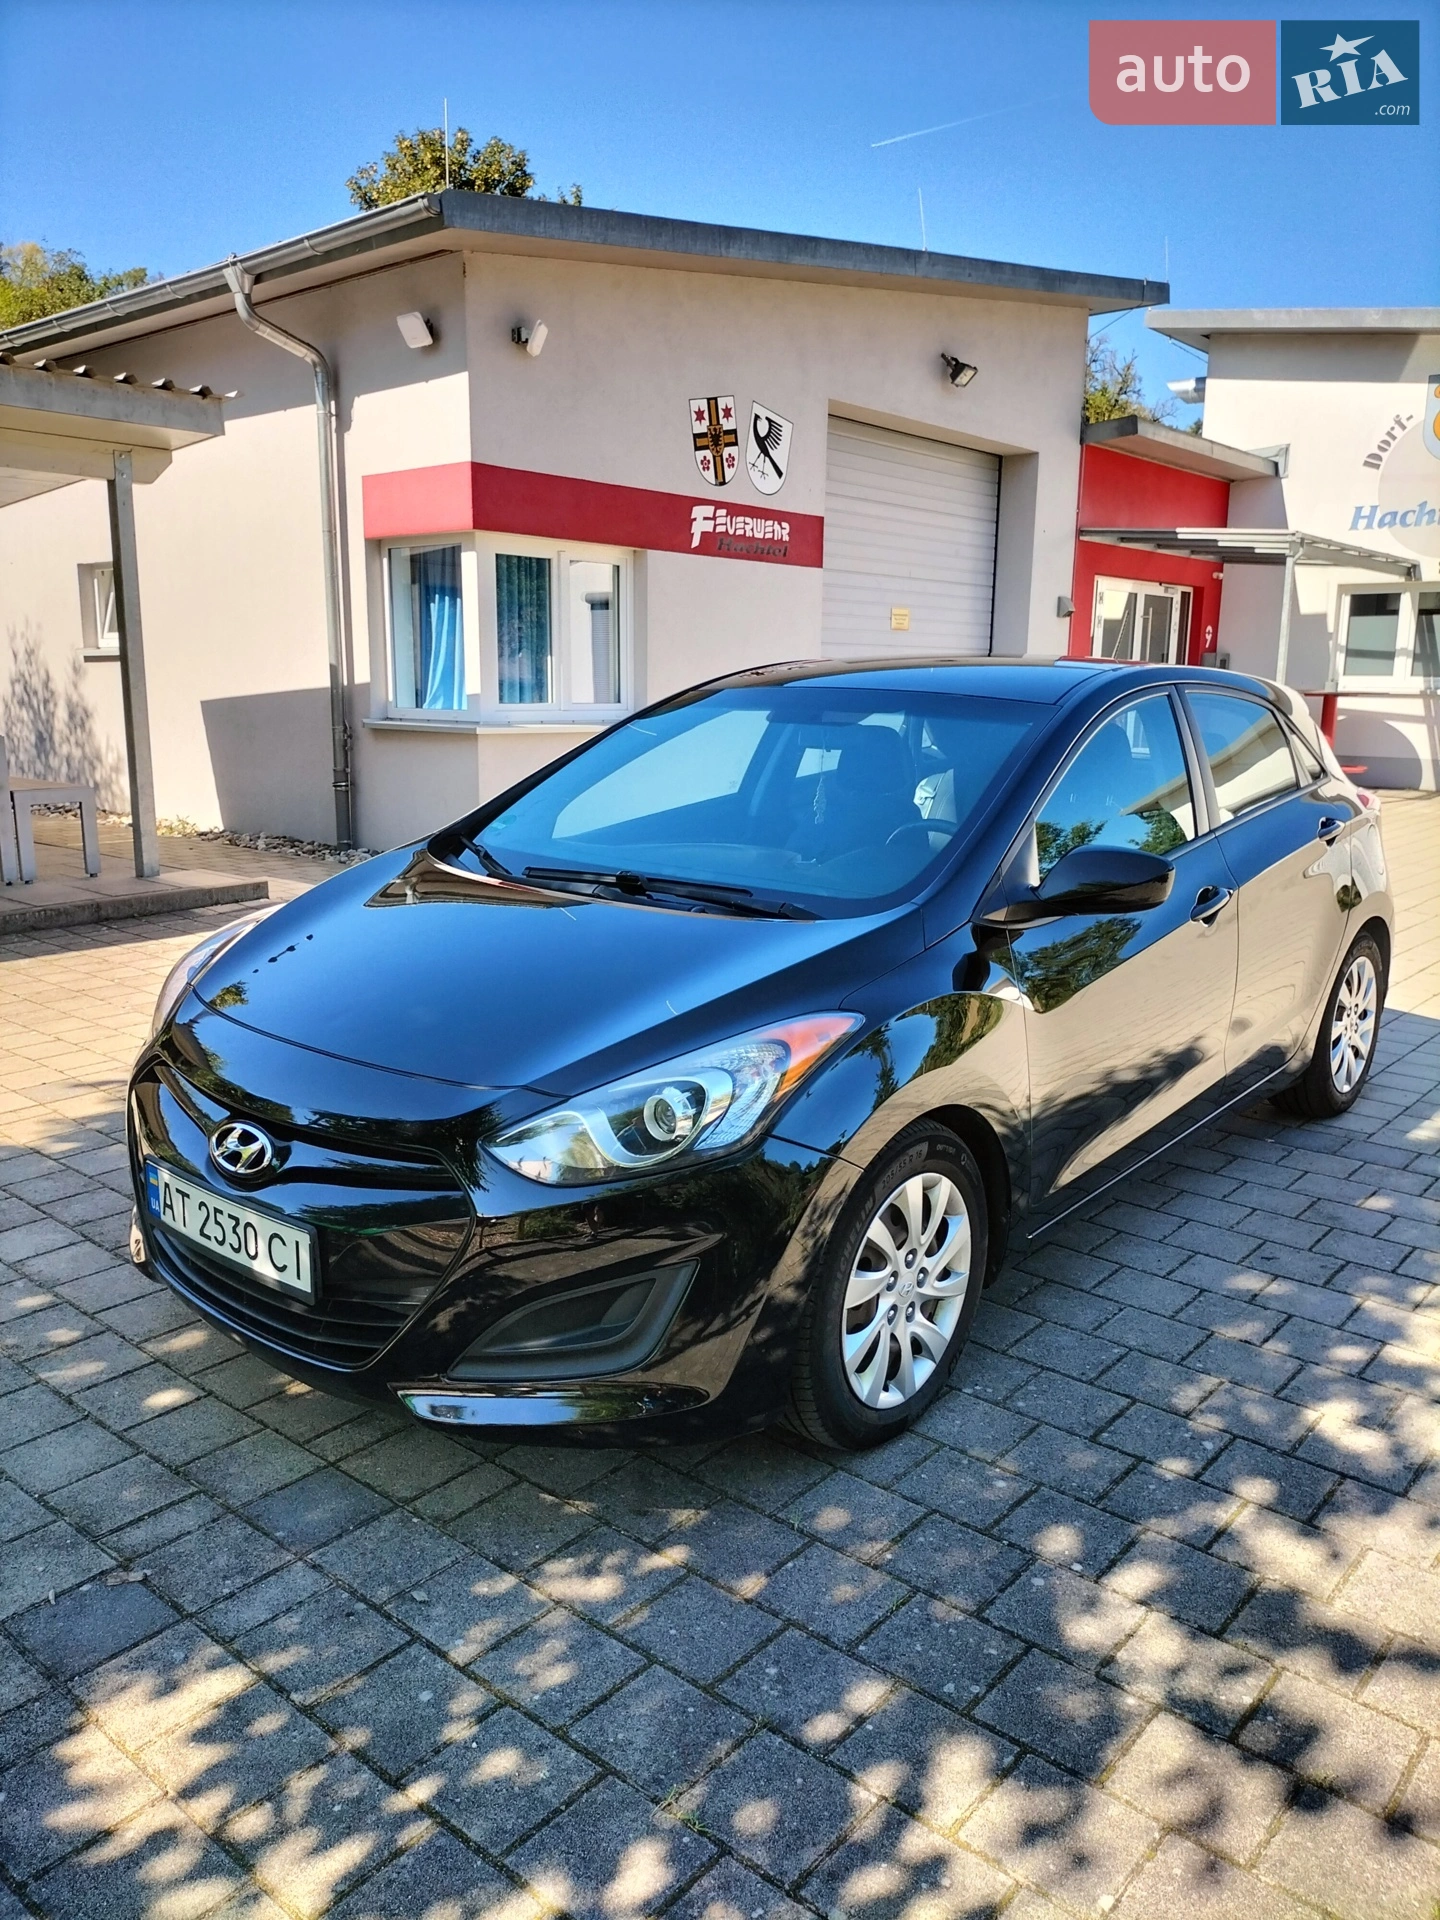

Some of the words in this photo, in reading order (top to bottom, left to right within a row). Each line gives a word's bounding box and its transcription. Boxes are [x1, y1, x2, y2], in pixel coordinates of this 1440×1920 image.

[1362, 414, 1414, 471] Dorf-
[1348, 500, 1440, 531] Hach
[717, 537, 788, 558] Hachtel
[1205, 624, 1213, 649] 9
[150, 1197, 160, 1211] UA
[162, 1182, 190, 1228] AT
[198, 1201, 258, 1260] 2530
[268, 1233, 301, 1280] CI
[832, 1196, 874, 1300] MICHELIN
